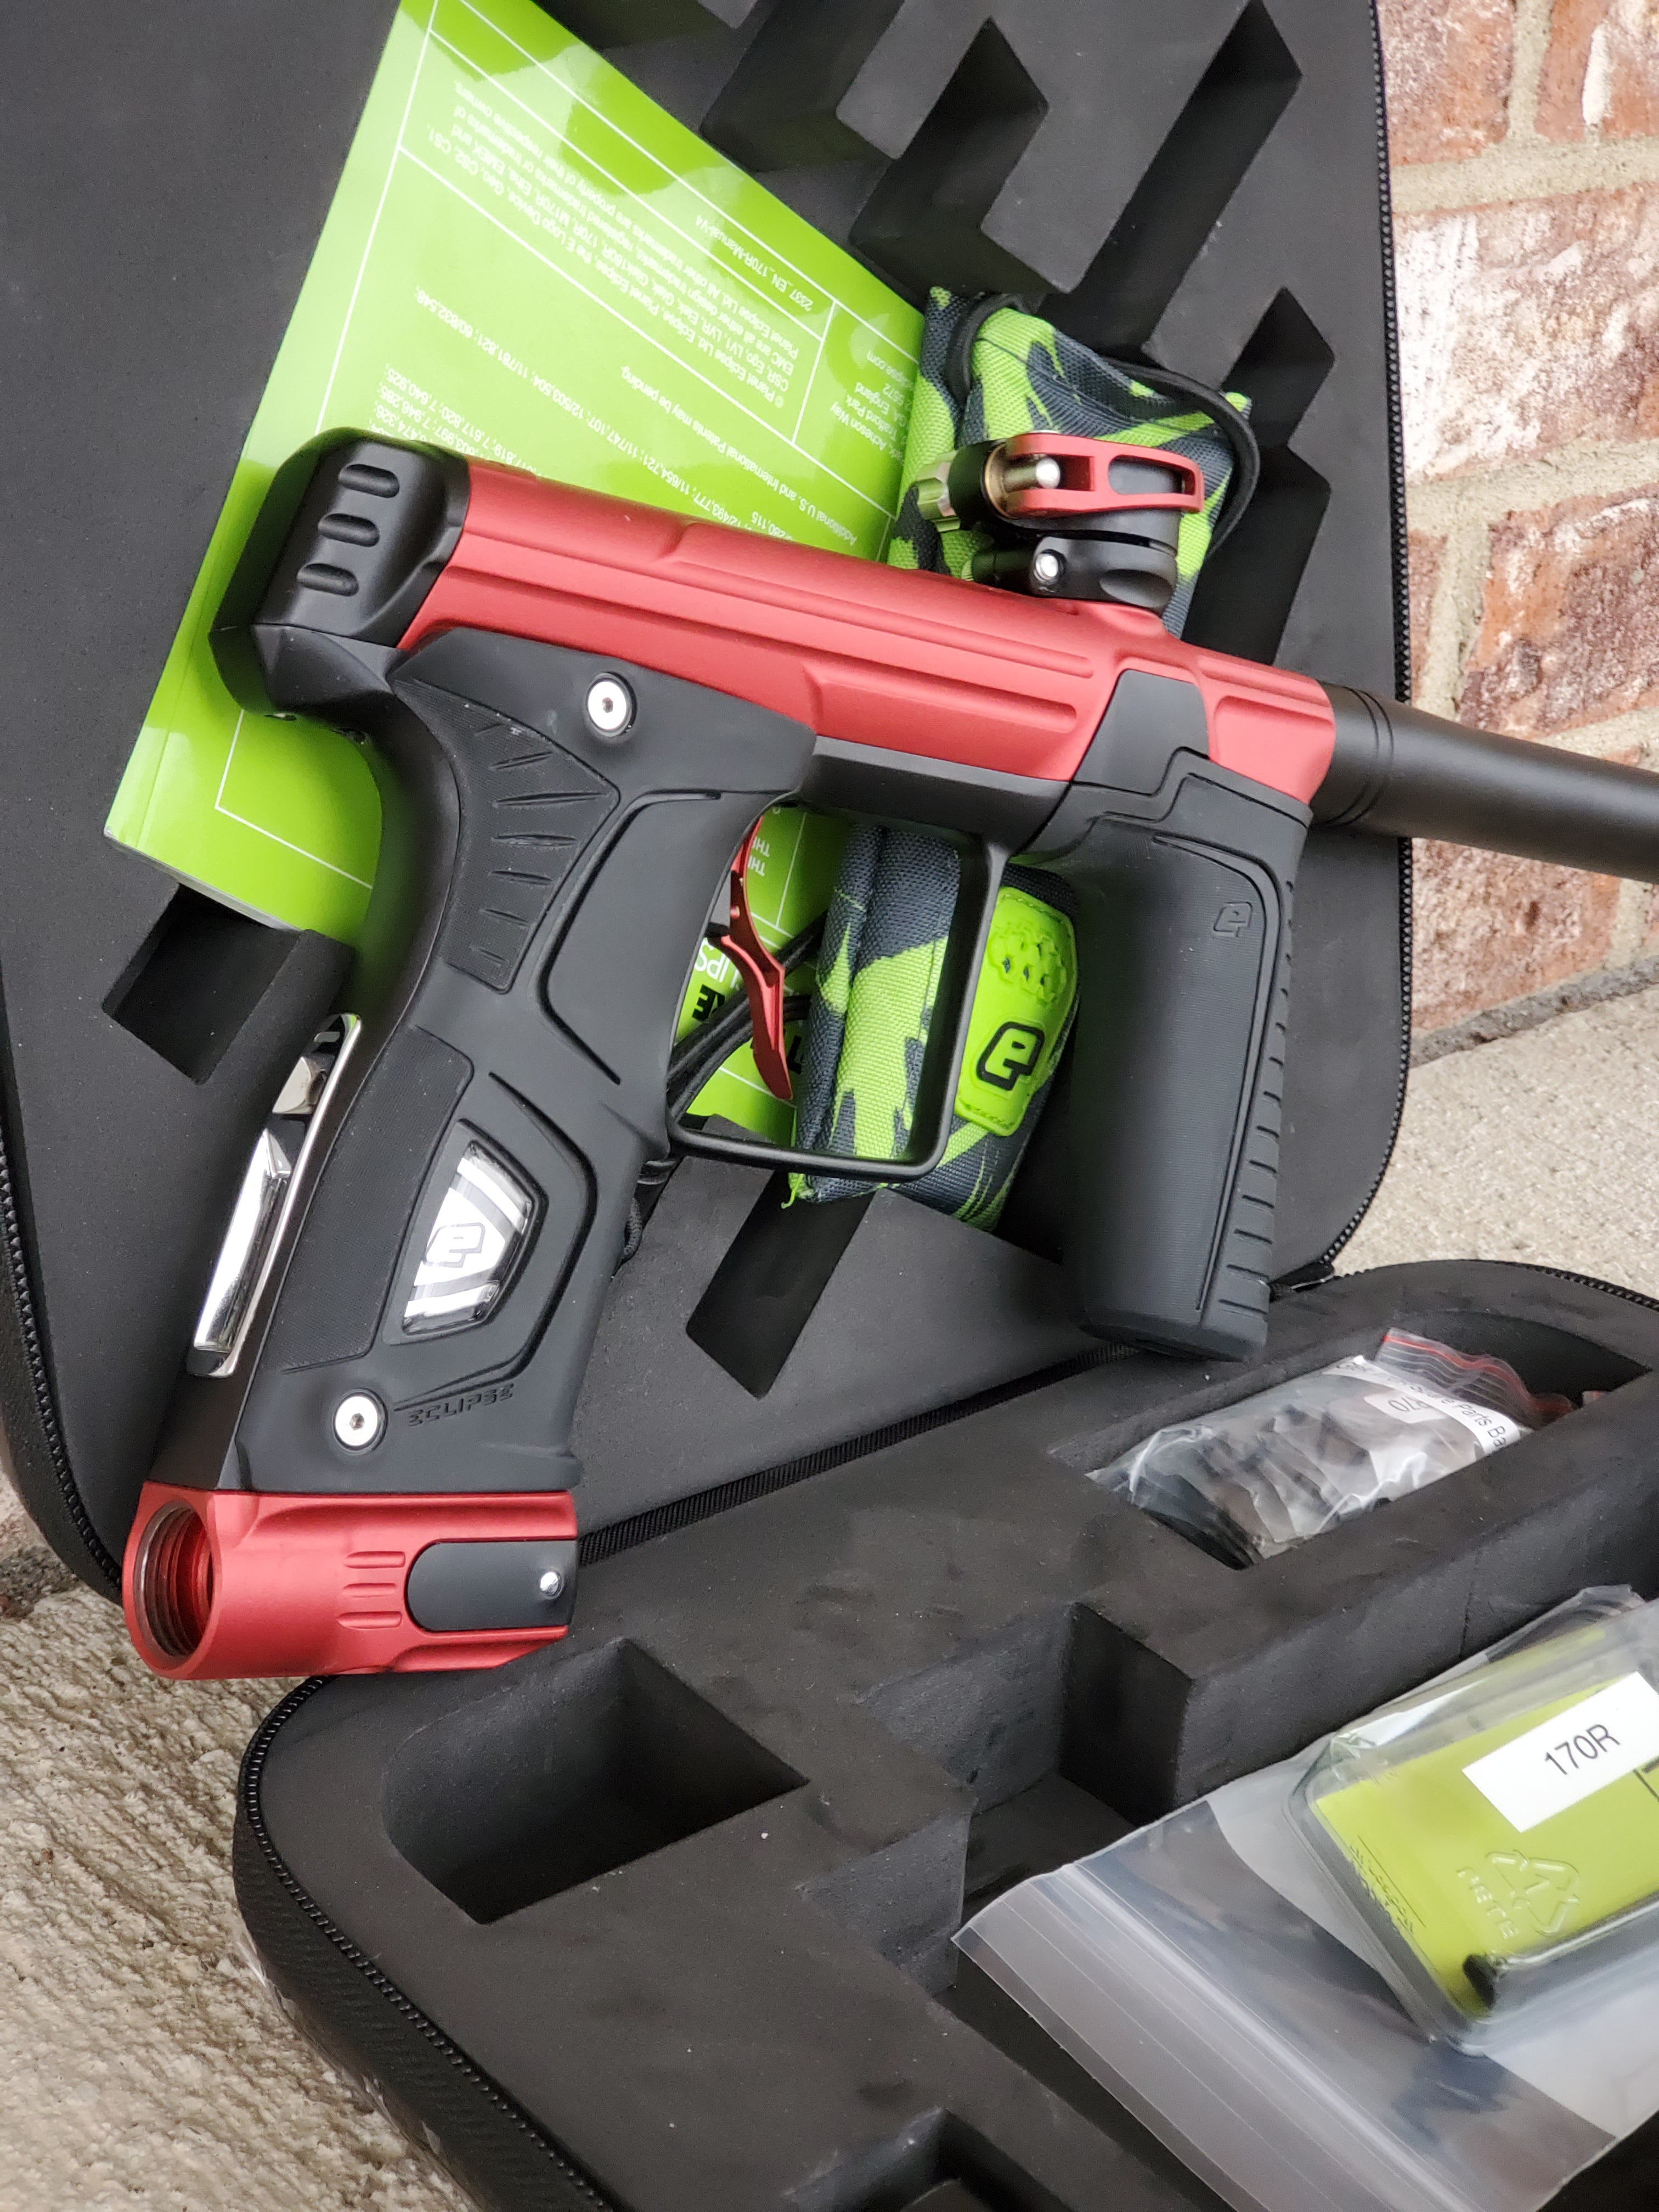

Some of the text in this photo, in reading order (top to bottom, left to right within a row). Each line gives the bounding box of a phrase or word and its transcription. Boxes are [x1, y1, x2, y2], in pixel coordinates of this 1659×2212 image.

[453, 102, 466, 122] of
[451, 123, 472, 148] and
[466, 113, 522, 166] trademarks
[492, 111, 543, 160] respective
[522, 157, 534, 174] or
[542, 152, 565, 179] their
[563, 170, 576, 189] of
[533, 167, 587, 218] trademarks
[575, 176, 616, 218] property
[540, 214, 567, 245] Logo
[586, 206, 634, 255] registered
[614, 210, 631, 230] are
[565, 235, 575, 253] E
[575, 243, 592, 265] the
[631, 222, 683, 272] trademarks
[592, 254, 630, 294] Eclipse,
[682, 262, 707, 291] other
[629, 284, 659, 317] Planet
[686, 284, 718, 318] design
[707, 281, 721, 301] All
[659, 305, 696, 343] Eclipse,
[716, 309, 743, 338] either
[738, 302, 771, 339] Eclipse
[696, 334, 714, 357] Ltd.
[743, 329, 755, 347] all
[755, 338, 771, 357] are
[769, 329, 798, 360] Planet
[713, 346, 747, 382] Eclipse
[743, 347, 765, 375] Ego,
[770, 349, 794, 377] EMC
[746, 372, 775, 403] Planet
[764, 364, 789, 393] CSR,
[829, 398, 851, 426] Way
[844, 392, 866, 418] Park
[854, 377, 890, 416] England
[849, 416, 886, 453] Acheson
[865, 408, 898, 442] Trafford
[618, 363, 856, 548] Additional U.S. and International Patents may be pending.
[408, 1383, 515, 1427] ECLIPSE
[1544, 1724, 1621, 1775] 170R
